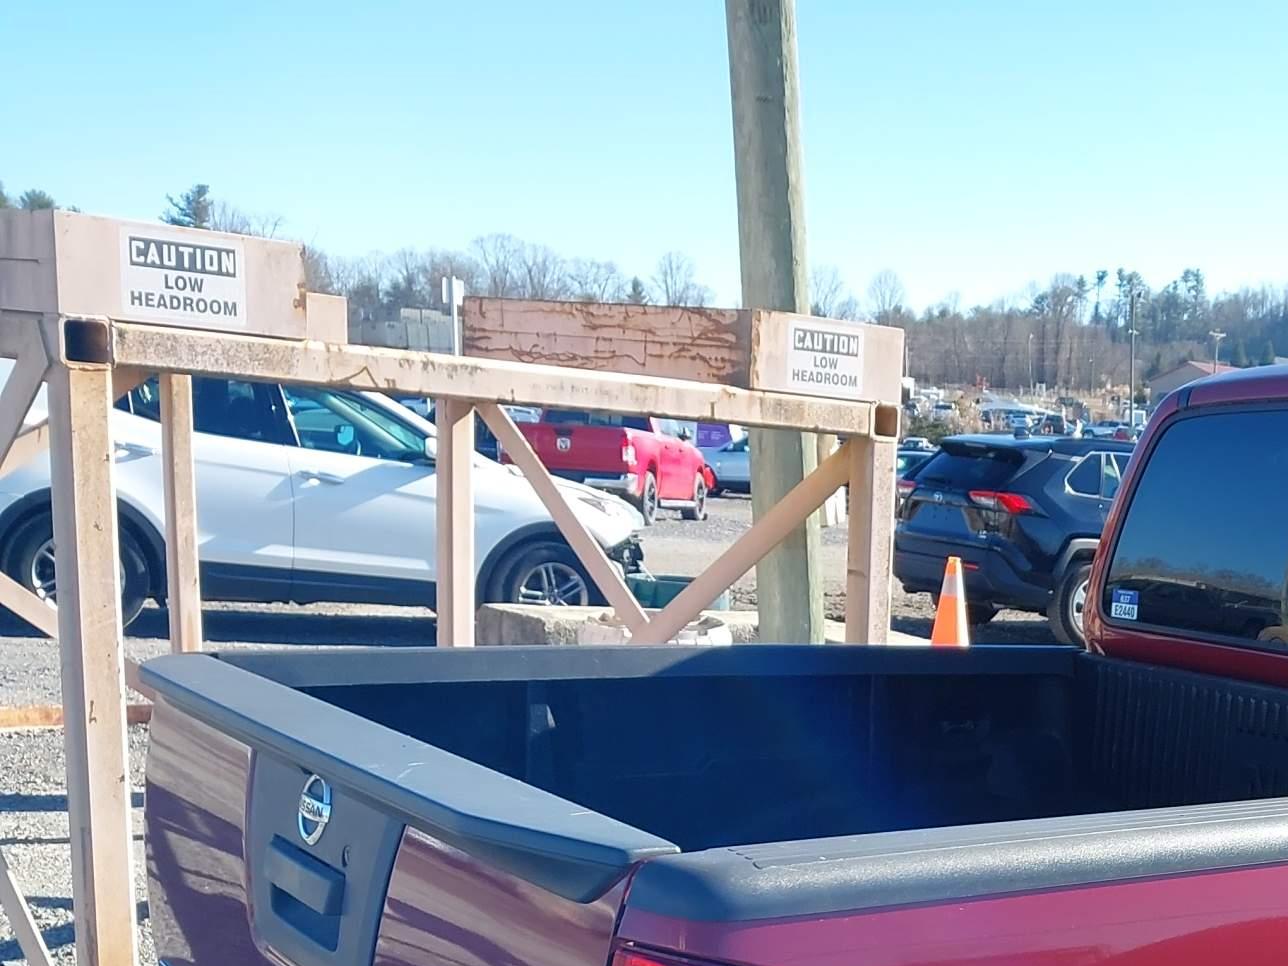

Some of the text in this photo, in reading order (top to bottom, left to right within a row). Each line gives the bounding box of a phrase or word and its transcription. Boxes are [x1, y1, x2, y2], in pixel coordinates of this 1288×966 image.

[131, 239, 235, 275] CAUTION
[164, 274, 204, 293] LOW
[130, 290, 237, 317] HEADROOM
[795, 330, 858, 355] CAUTION
[814, 355, 838, 370] LOW
[792, 368, 857, 387] HEADROOM
